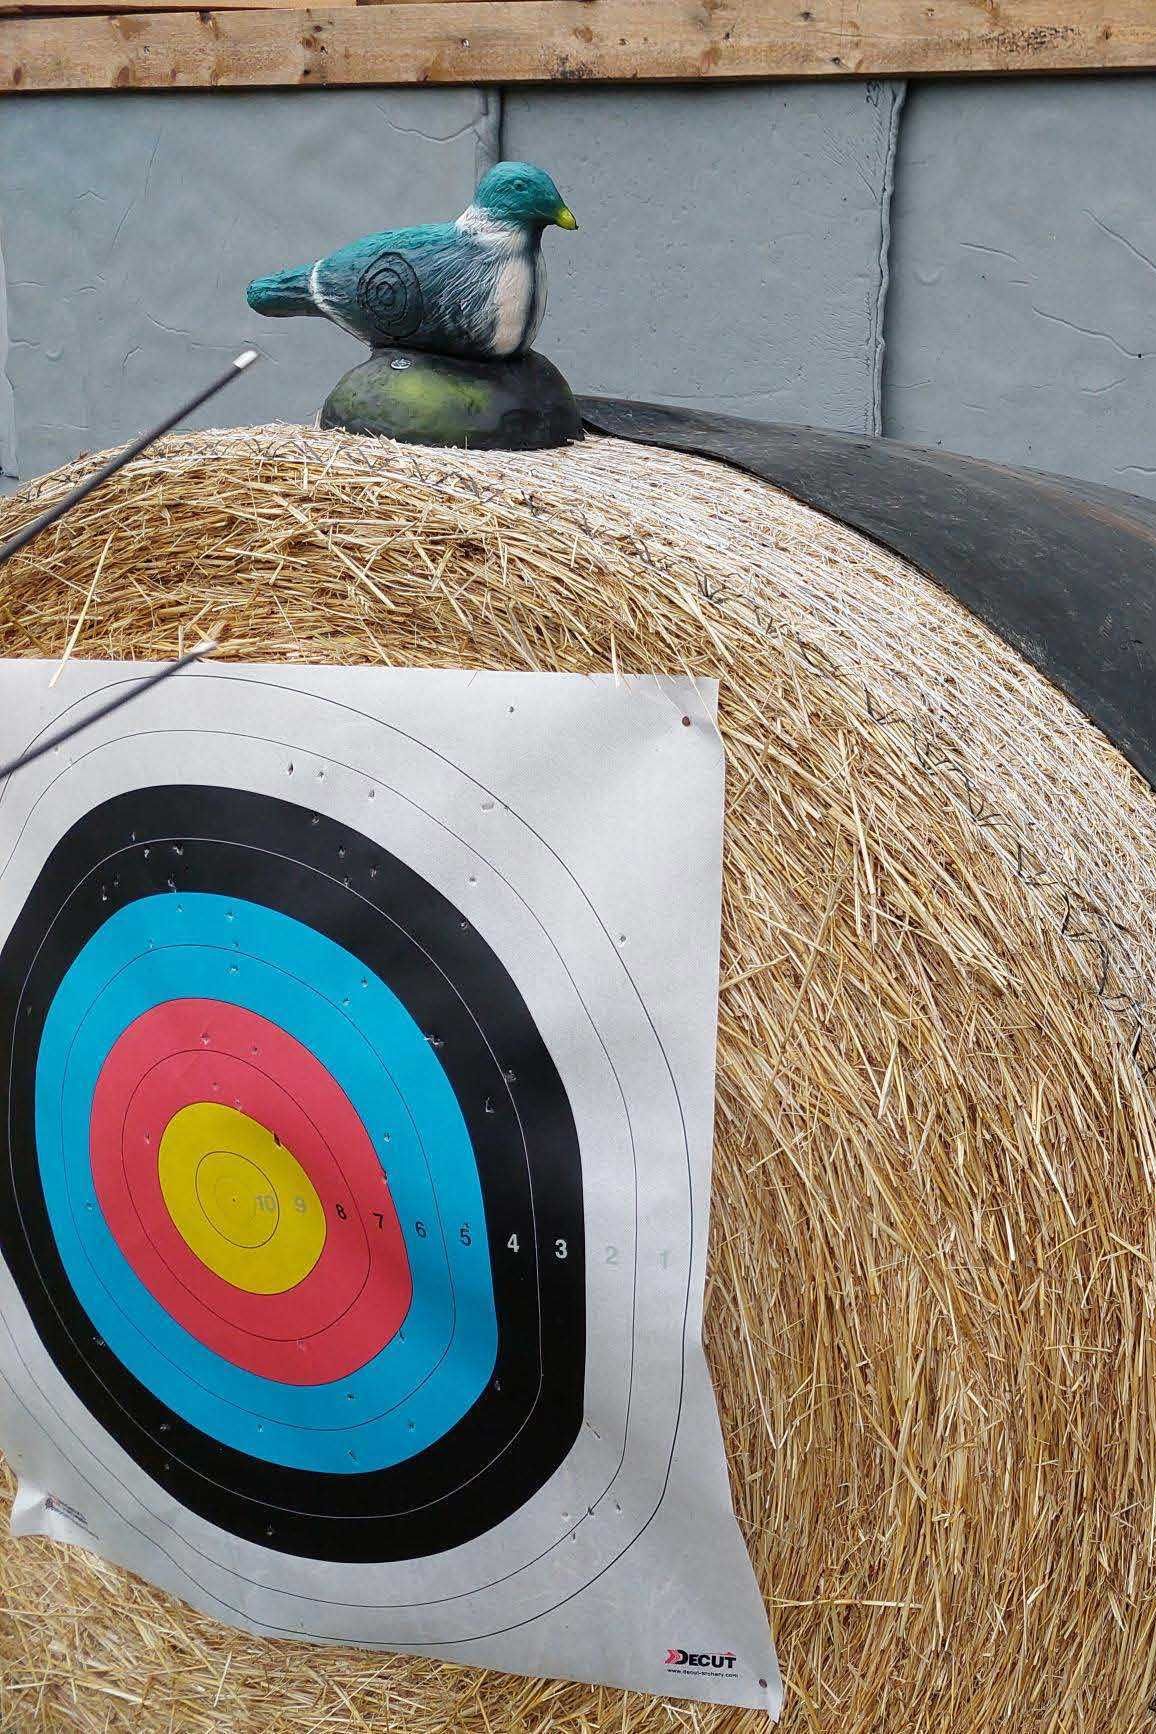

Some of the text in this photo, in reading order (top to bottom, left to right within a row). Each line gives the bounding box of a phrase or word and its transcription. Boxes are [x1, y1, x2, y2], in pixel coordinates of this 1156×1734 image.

[256, 1193, 669, 1269] 10 9 8 7 6 5 4 3 2 1
[664, 1649, 737, 1669] DECUT
